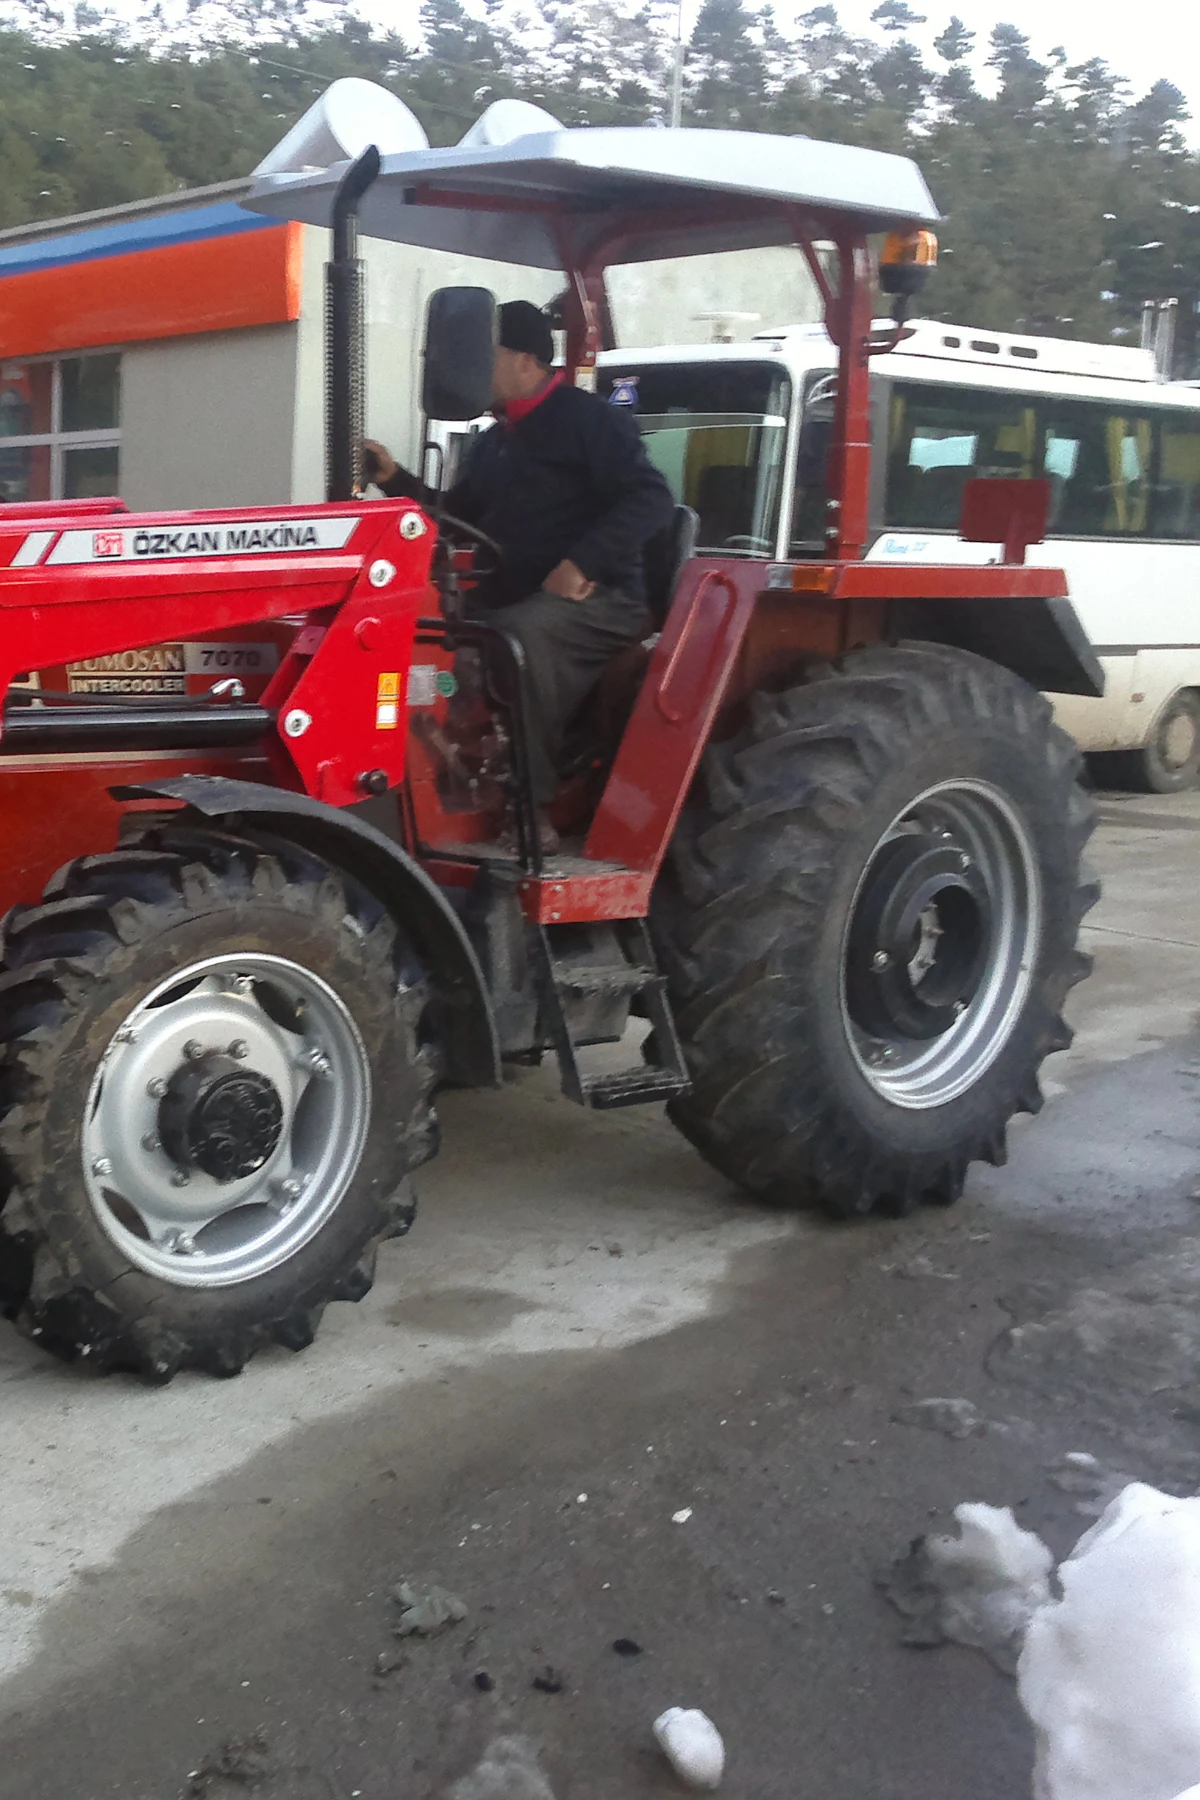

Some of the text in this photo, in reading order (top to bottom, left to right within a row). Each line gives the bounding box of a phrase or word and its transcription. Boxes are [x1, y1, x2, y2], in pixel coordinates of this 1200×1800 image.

[133, 530, 220, 555] ÖZKAN
[225, 523, 319, 550] MAKİNA
[200, 650, 260, 667] 7070
[71, 679, 184, 693] INTERCOOLER
